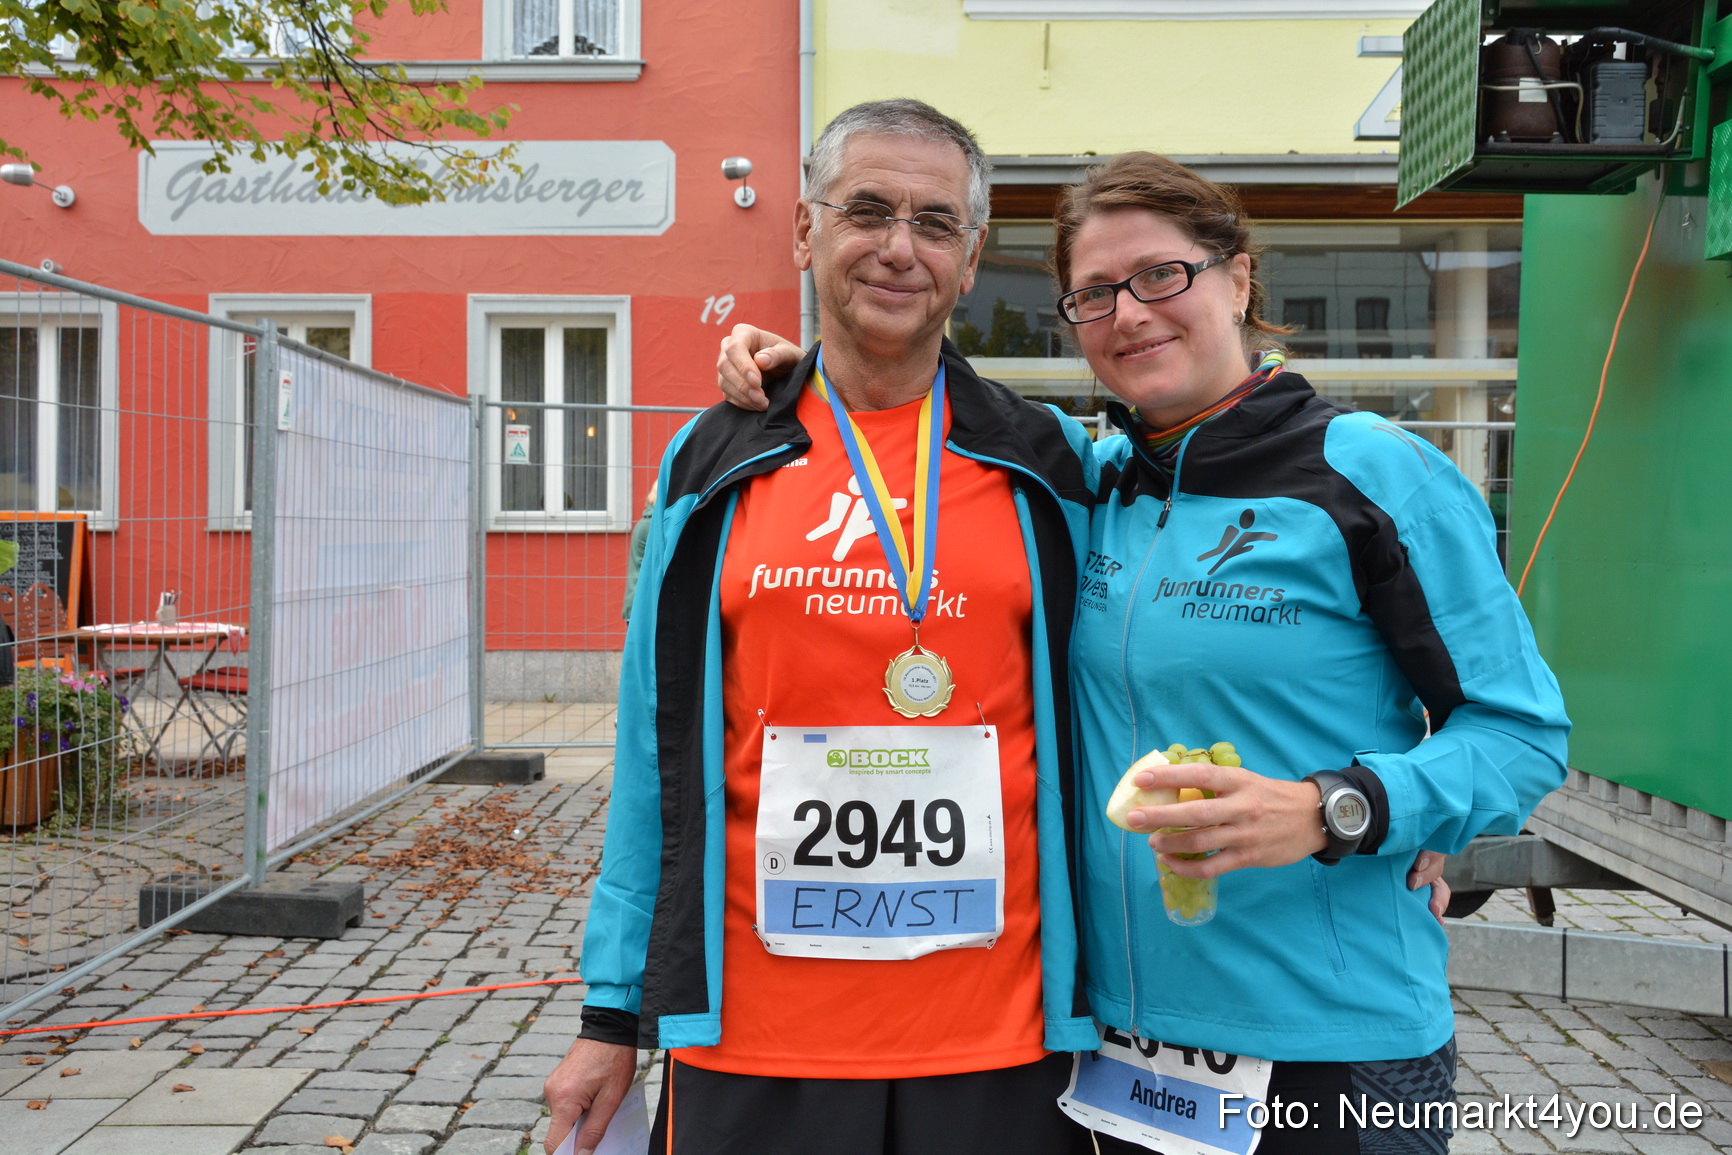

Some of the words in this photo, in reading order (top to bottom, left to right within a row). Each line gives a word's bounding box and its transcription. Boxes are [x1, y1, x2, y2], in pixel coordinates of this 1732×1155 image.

[700, 294, 736, 326] 19
[1151, 577, 1286, 603] funrunners
[1181, 602, 1303, 626] neumarkt
[848, 748, 931, 769] BOCK
[848, 768, 875, 776] inspired
[875, 768, 885, 776] by
[904, 768, 932, 776] concepts
[793, 798, 966, 869] 2949
[770, 857, 778, 870] D
[791, 886, 975, 929] ERNST
[1129, 1078, 1197, 1120] Andrea
